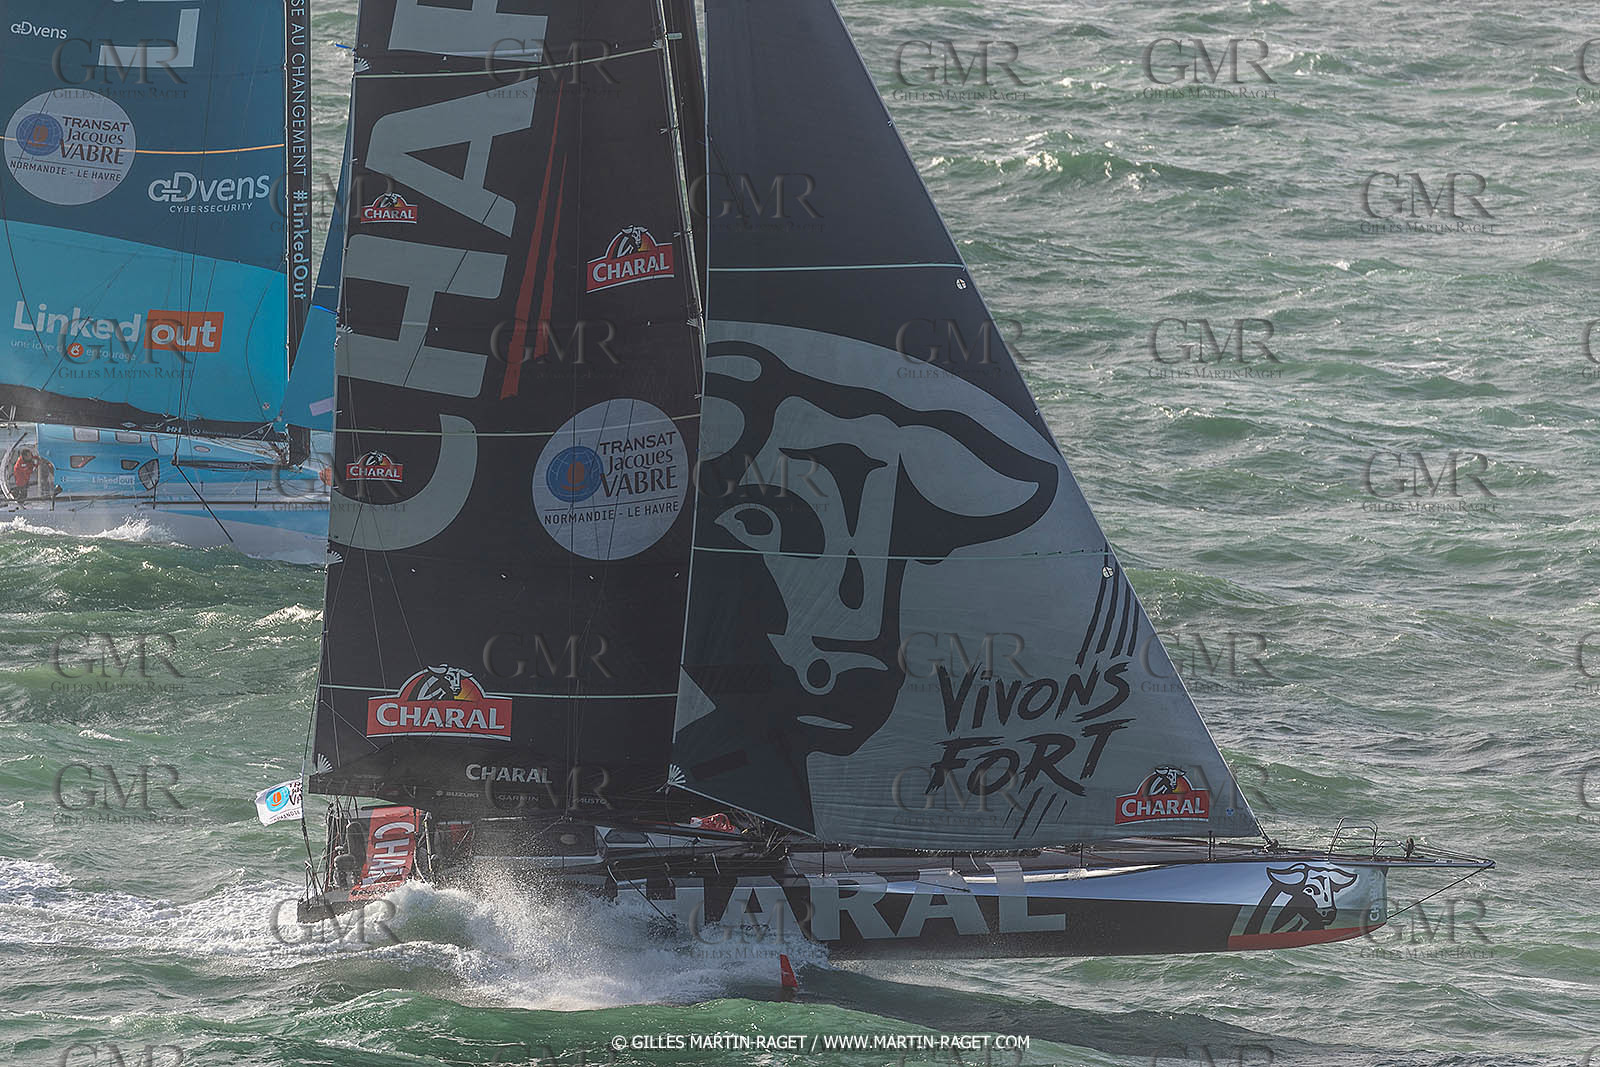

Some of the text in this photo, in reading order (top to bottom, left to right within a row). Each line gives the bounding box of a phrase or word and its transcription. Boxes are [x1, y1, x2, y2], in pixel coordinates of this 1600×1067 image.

[291, 23, 304, 44] AU
[62, 116, 130, 132] TRANSAT
[291, 53, 306, 176] CHANGEMENT
[66, 128, 124, 145] Jacques
[59, 139, 124, 165] VABRE
[10, 160, 68, 176] NORMANDIE
[77, 169, 88, 179] LE
[91, 171, 122, 182] HAVRE
[169, 202, 253, 213] CYBERSECURITY
[364, 208, 415, 220] CHARAL
[292, 190, 309, 300] #LinkedOut
[593, 253, 670, 283] CHARAL
[14, 301, 217, 347] Linked out
[600, 432, 676, 455] TRANSAT
[350, 466, 400, 478] CHARAL
[606, 449, 674, 475] Jacques
[600, 465, 678, 498] VABRE
[544, 508, 616, 525] NORMANDIE
[628, 506, 642, 518] LE
[645, 501, 679, 516] HAVRE
[376, 703, 505, 730] CHARAL
[926, 718, 1136, 797] FORT
[466, 763, 552, 784] CHARAL
[1121, 797, 1205, 818] CHARAL
[617, 861, 1066, 942] HARAL
